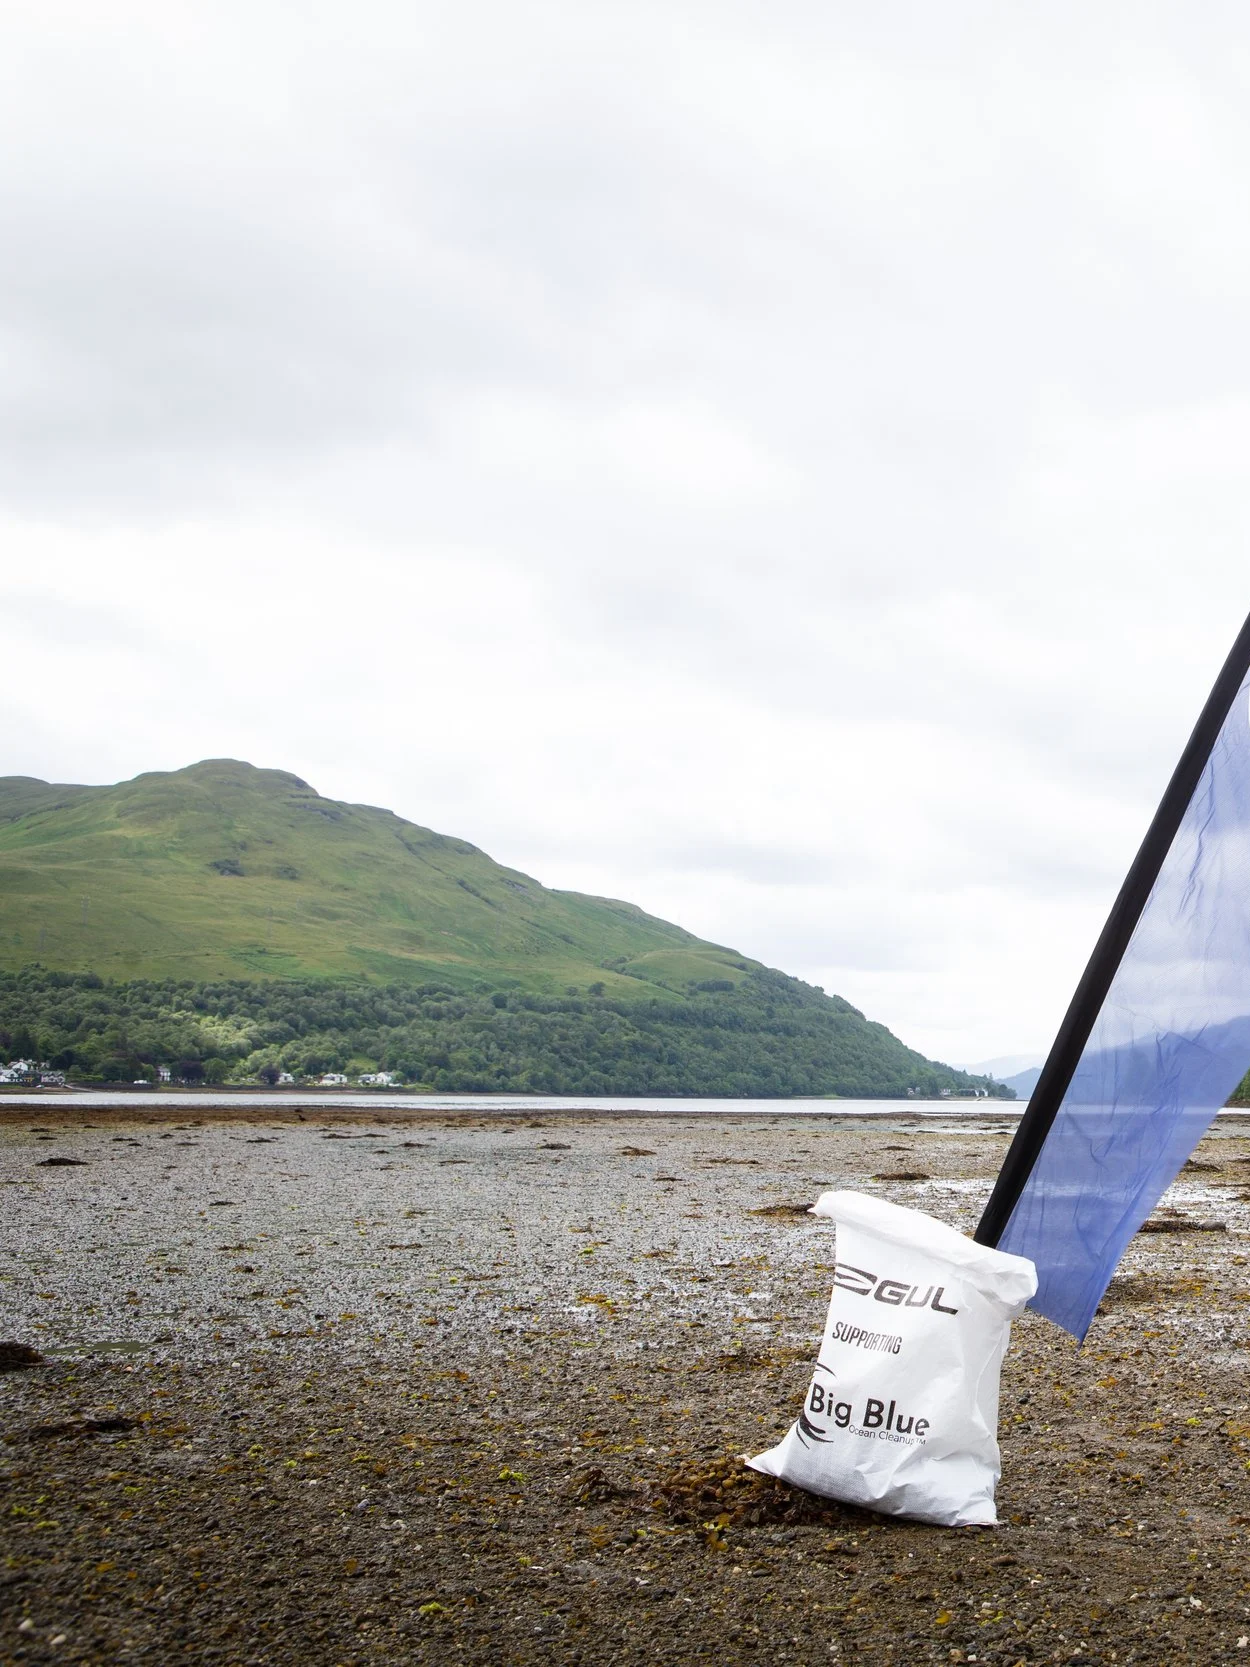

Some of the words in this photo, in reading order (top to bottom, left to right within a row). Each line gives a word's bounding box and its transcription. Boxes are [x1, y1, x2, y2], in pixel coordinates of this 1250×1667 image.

[873, 1279, 959, 1316] GUL
[832, 1321, 903, 1355] SUPPORTING
[809, 1382, 852, 1428] Big
[862, 1398, 930, 1437] Blue
[848, 1424, 876, 1439] Ocean
